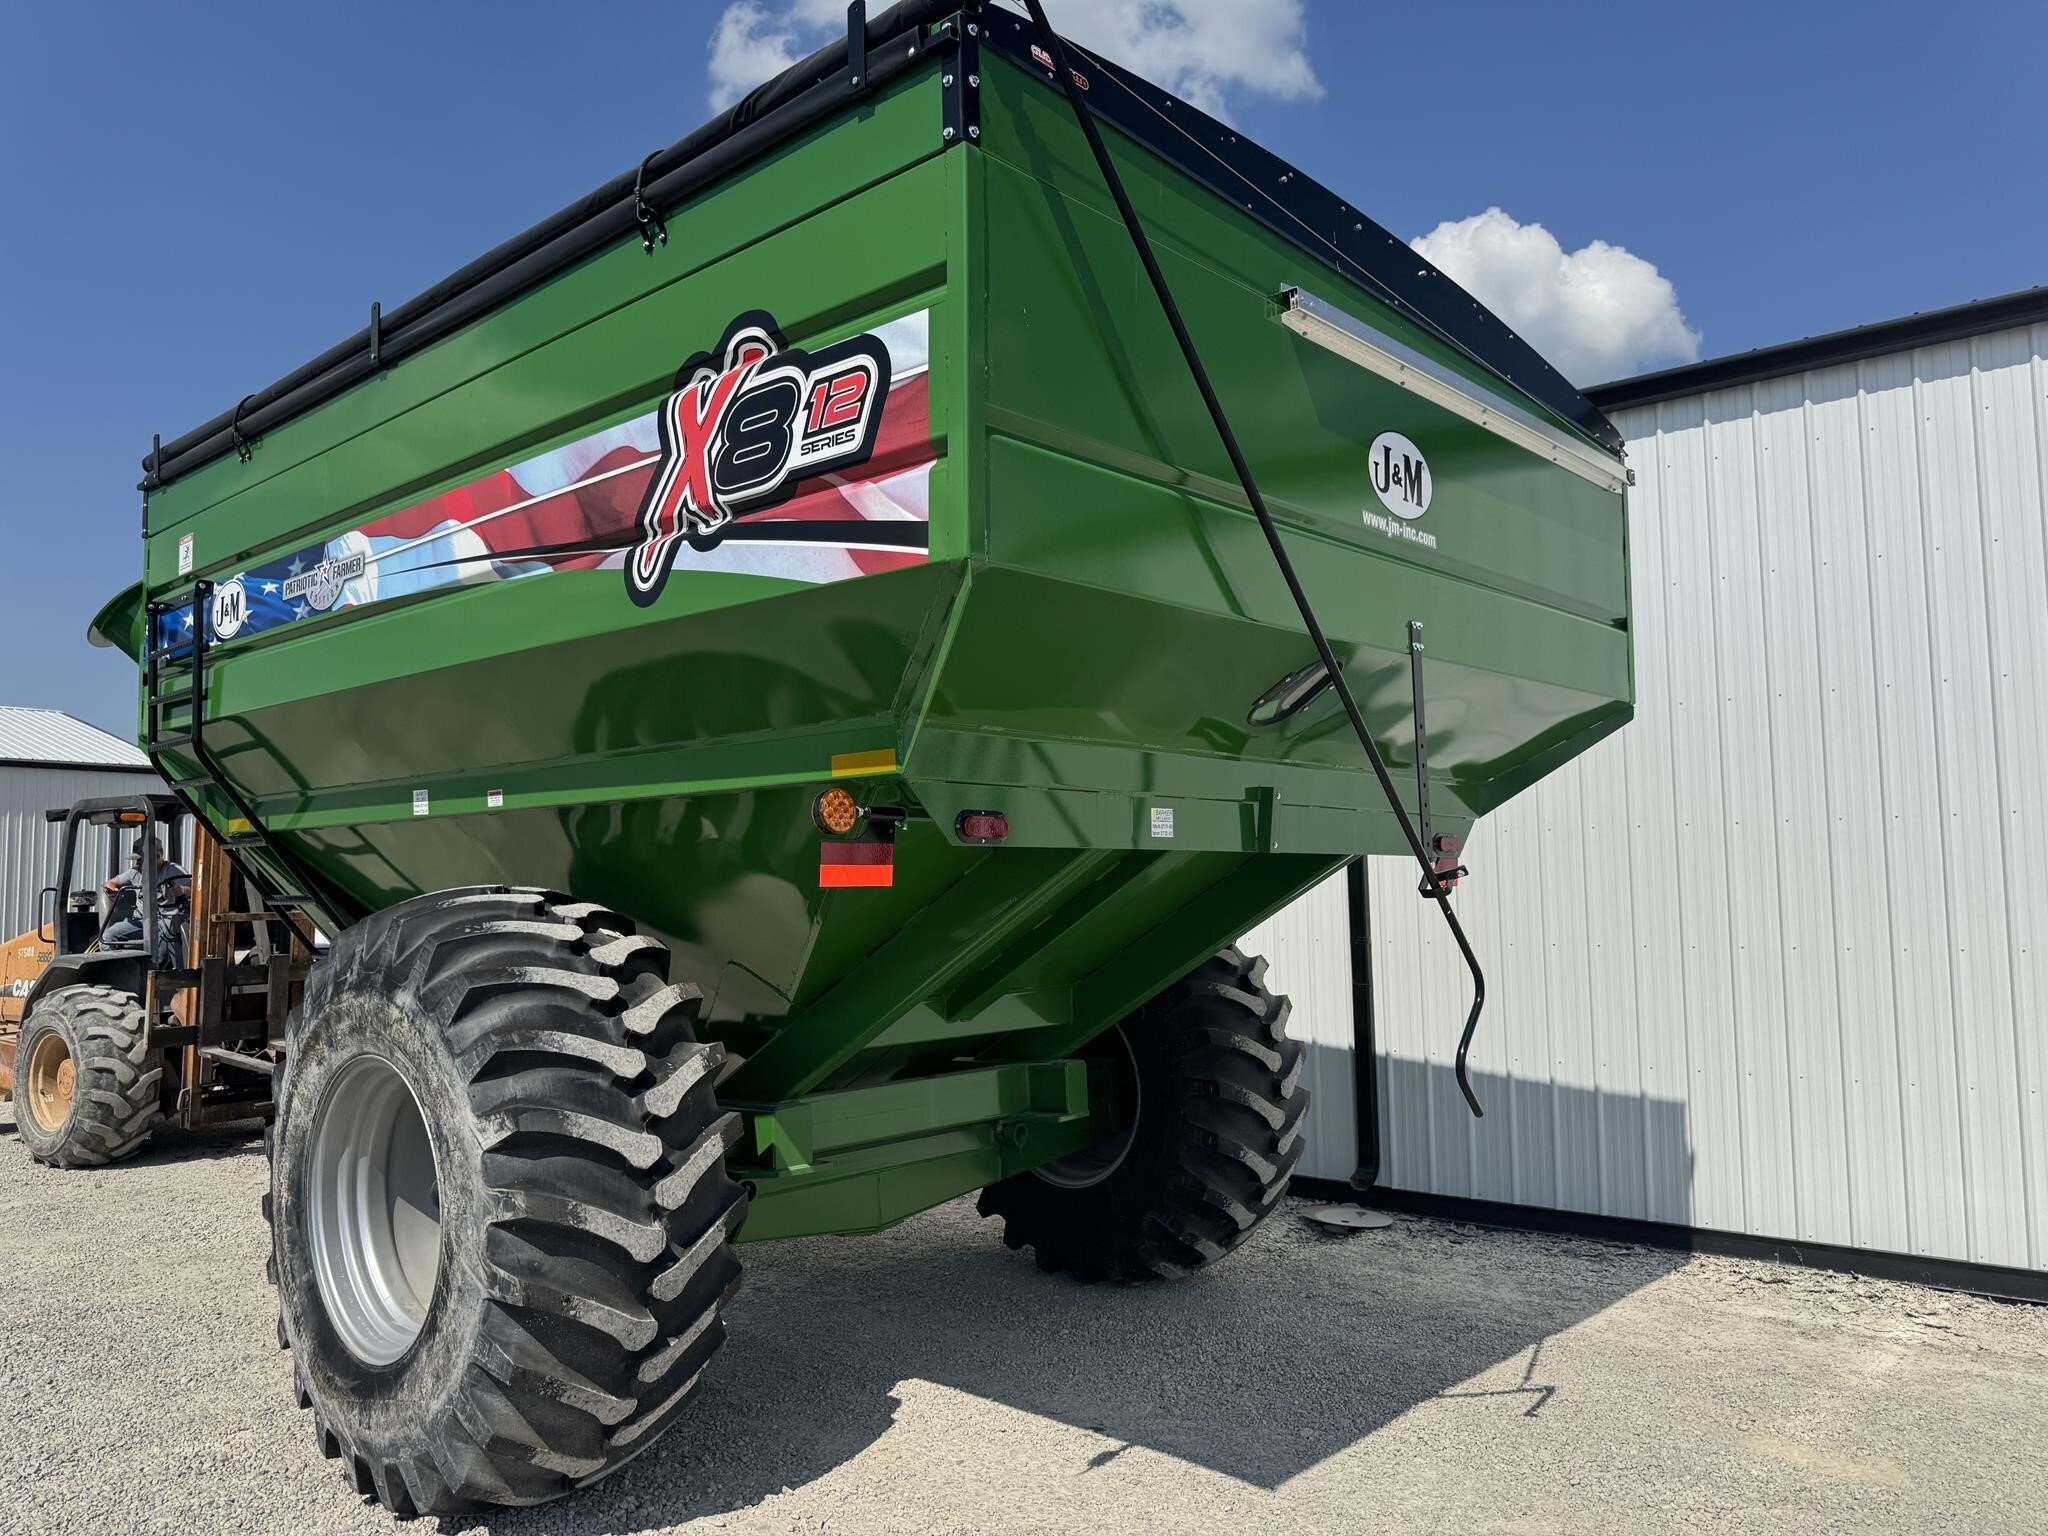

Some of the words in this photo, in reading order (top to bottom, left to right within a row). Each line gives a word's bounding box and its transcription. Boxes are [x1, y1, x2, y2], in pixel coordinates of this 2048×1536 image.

[800, 428, 856, 456] SERIES
[1373, 444, 1424, 508] J&M
[1362, 509, 1437, 549] www.jm-inc.com
[284, 572, 319, 597] PATRIOTIC
[332, 557, 362, 581] FARMER
[215, 590, 241, 628] J&M
